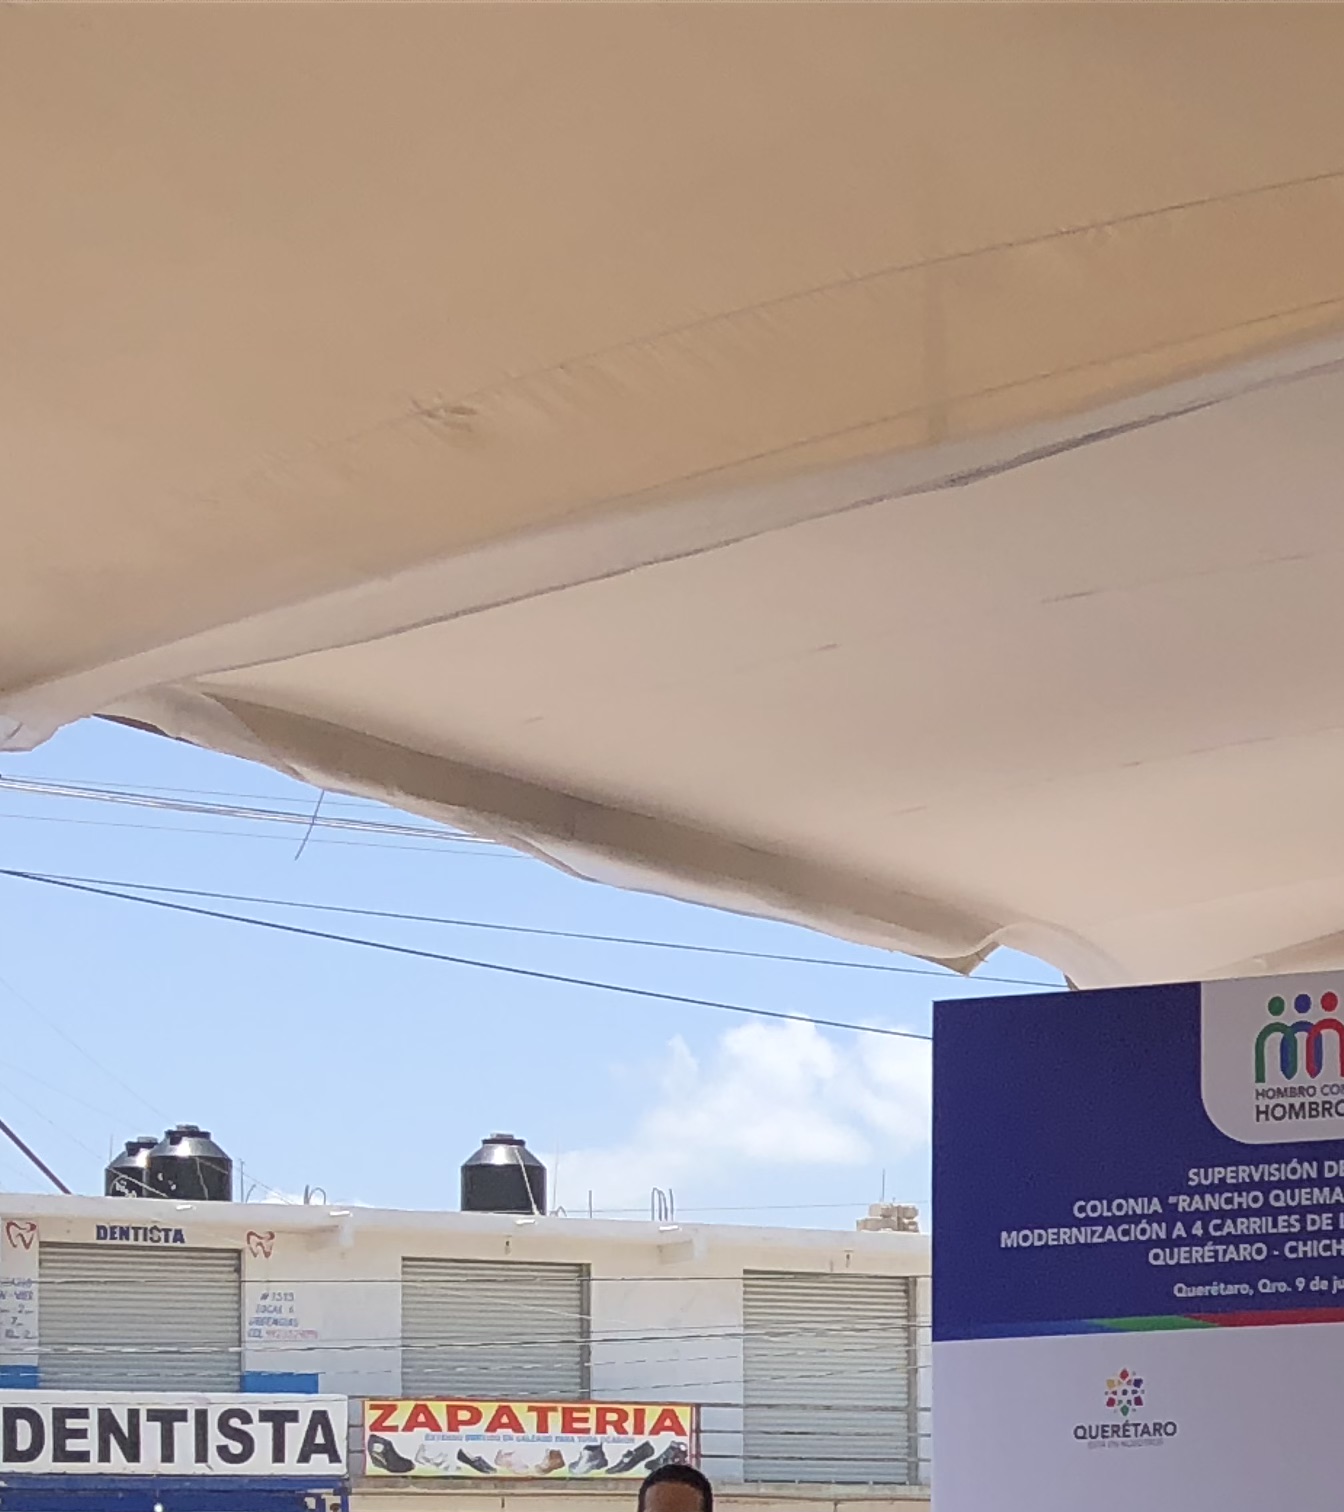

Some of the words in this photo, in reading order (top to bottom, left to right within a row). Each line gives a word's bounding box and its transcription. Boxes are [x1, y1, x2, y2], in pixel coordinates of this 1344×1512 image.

[1255, 1084, 1317, 1100] HOMBRO
[1187, 1159, 1318, 1186] SUPERVISIÓN
[1073, 1197, 1163, 1218] COLONIA
[96, 1224, 186, 1245] DENTISTA
[1000, 1220, 1167, 1248] MODERNIZACIÓN
[1172, 1221, 1188, 1239] A
[1191, 1220, 1204, 1237] 4
[1208, 1215, 1301, 1236] CARRILES
[1306, 1213, 1333, 1231] DE
[1148, 1242, 1268, 1266] QUERÉTARO
[1173, 1281, 1254, 1298] Querétaro,
[1258, 1278, 1292, 1293] Qro.
[1295, 1276, 1306, 1292] 9
[1309, 1275, 1328, 1291] de
[368, 1403, 688, 1437] ZAPATERIA
[1073, 1419, 1178, 1440] QUERÉTARO
[2, 1406, 343, 1465] DENTISTA
